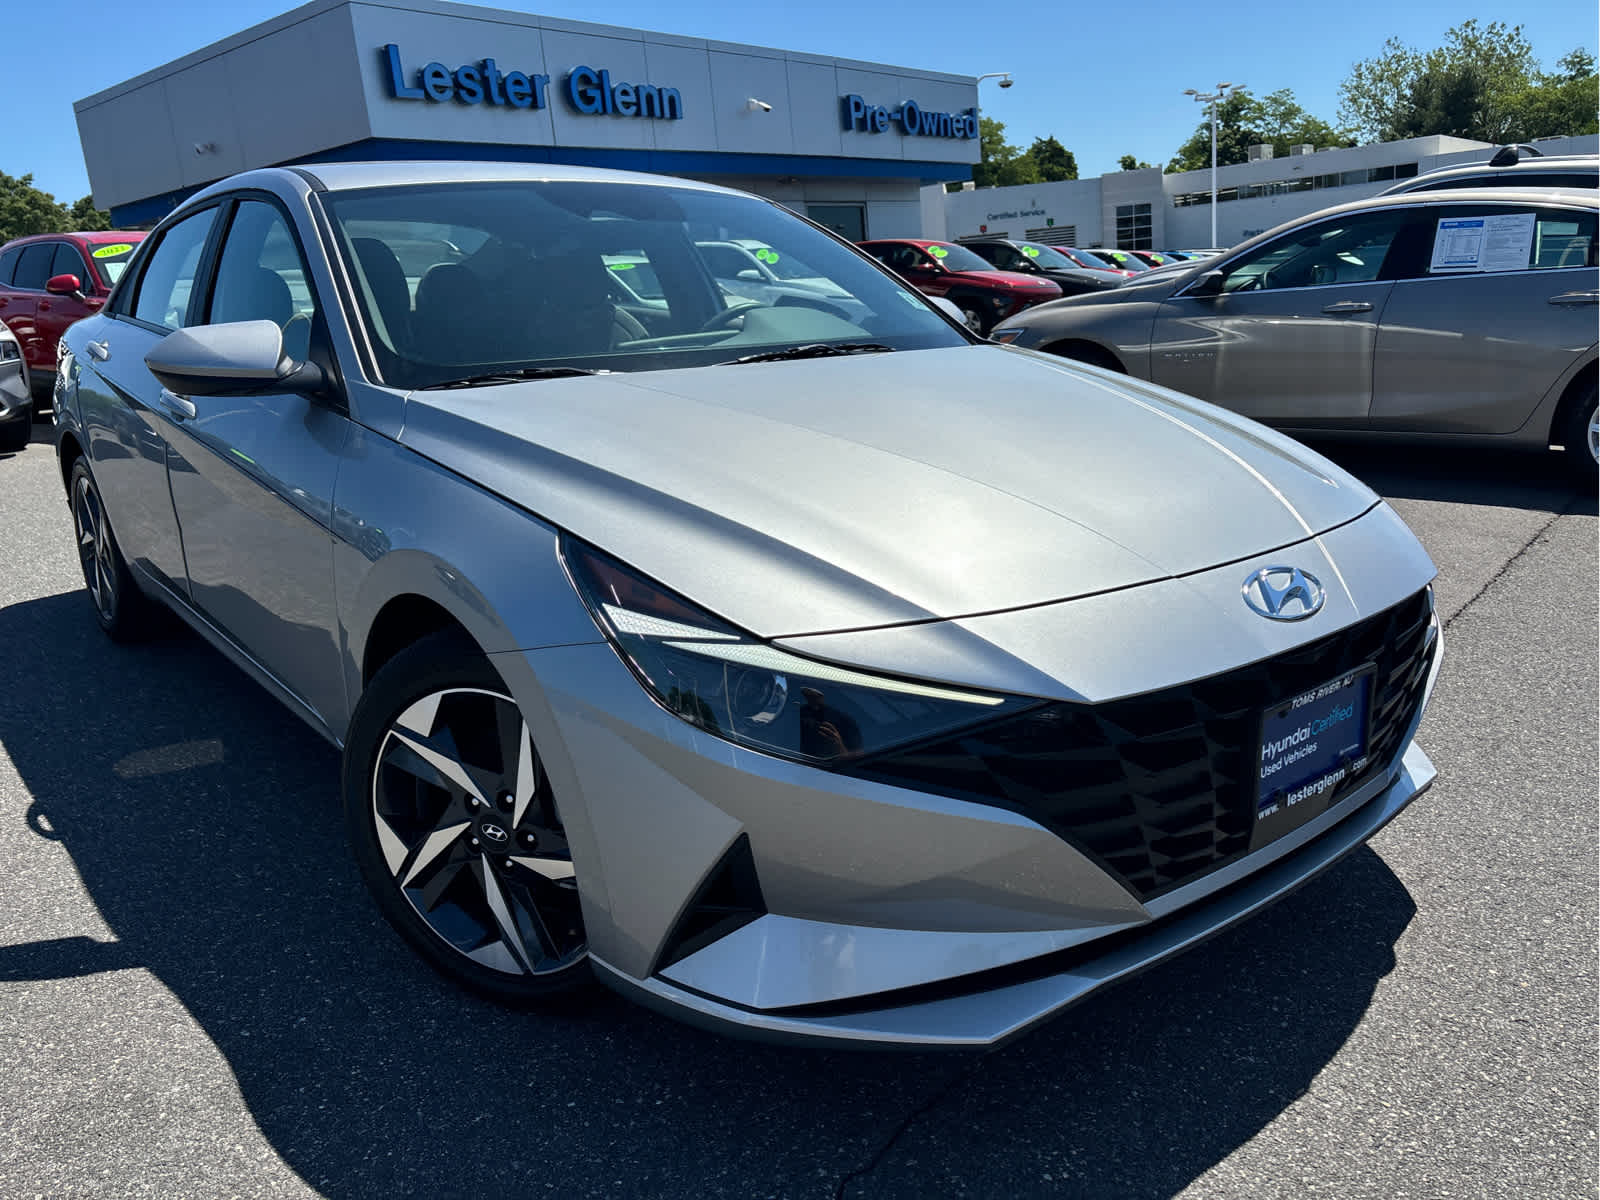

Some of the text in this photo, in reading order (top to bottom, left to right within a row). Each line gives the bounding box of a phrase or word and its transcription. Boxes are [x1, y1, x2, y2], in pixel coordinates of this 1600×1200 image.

[379, 43, 683, 120] Lester Glenn
[841, 94, 978, 139] Pre-Owned
[1291, 692, 1316, 710] TOMS
[1261, 703, 1353, 761] Hyundai Certified
[1260, 758, 1283, 779] Used
[1283, 742, 1318, 767] Vehicles
[1287, 768, 1345, 807] lesterglenn
